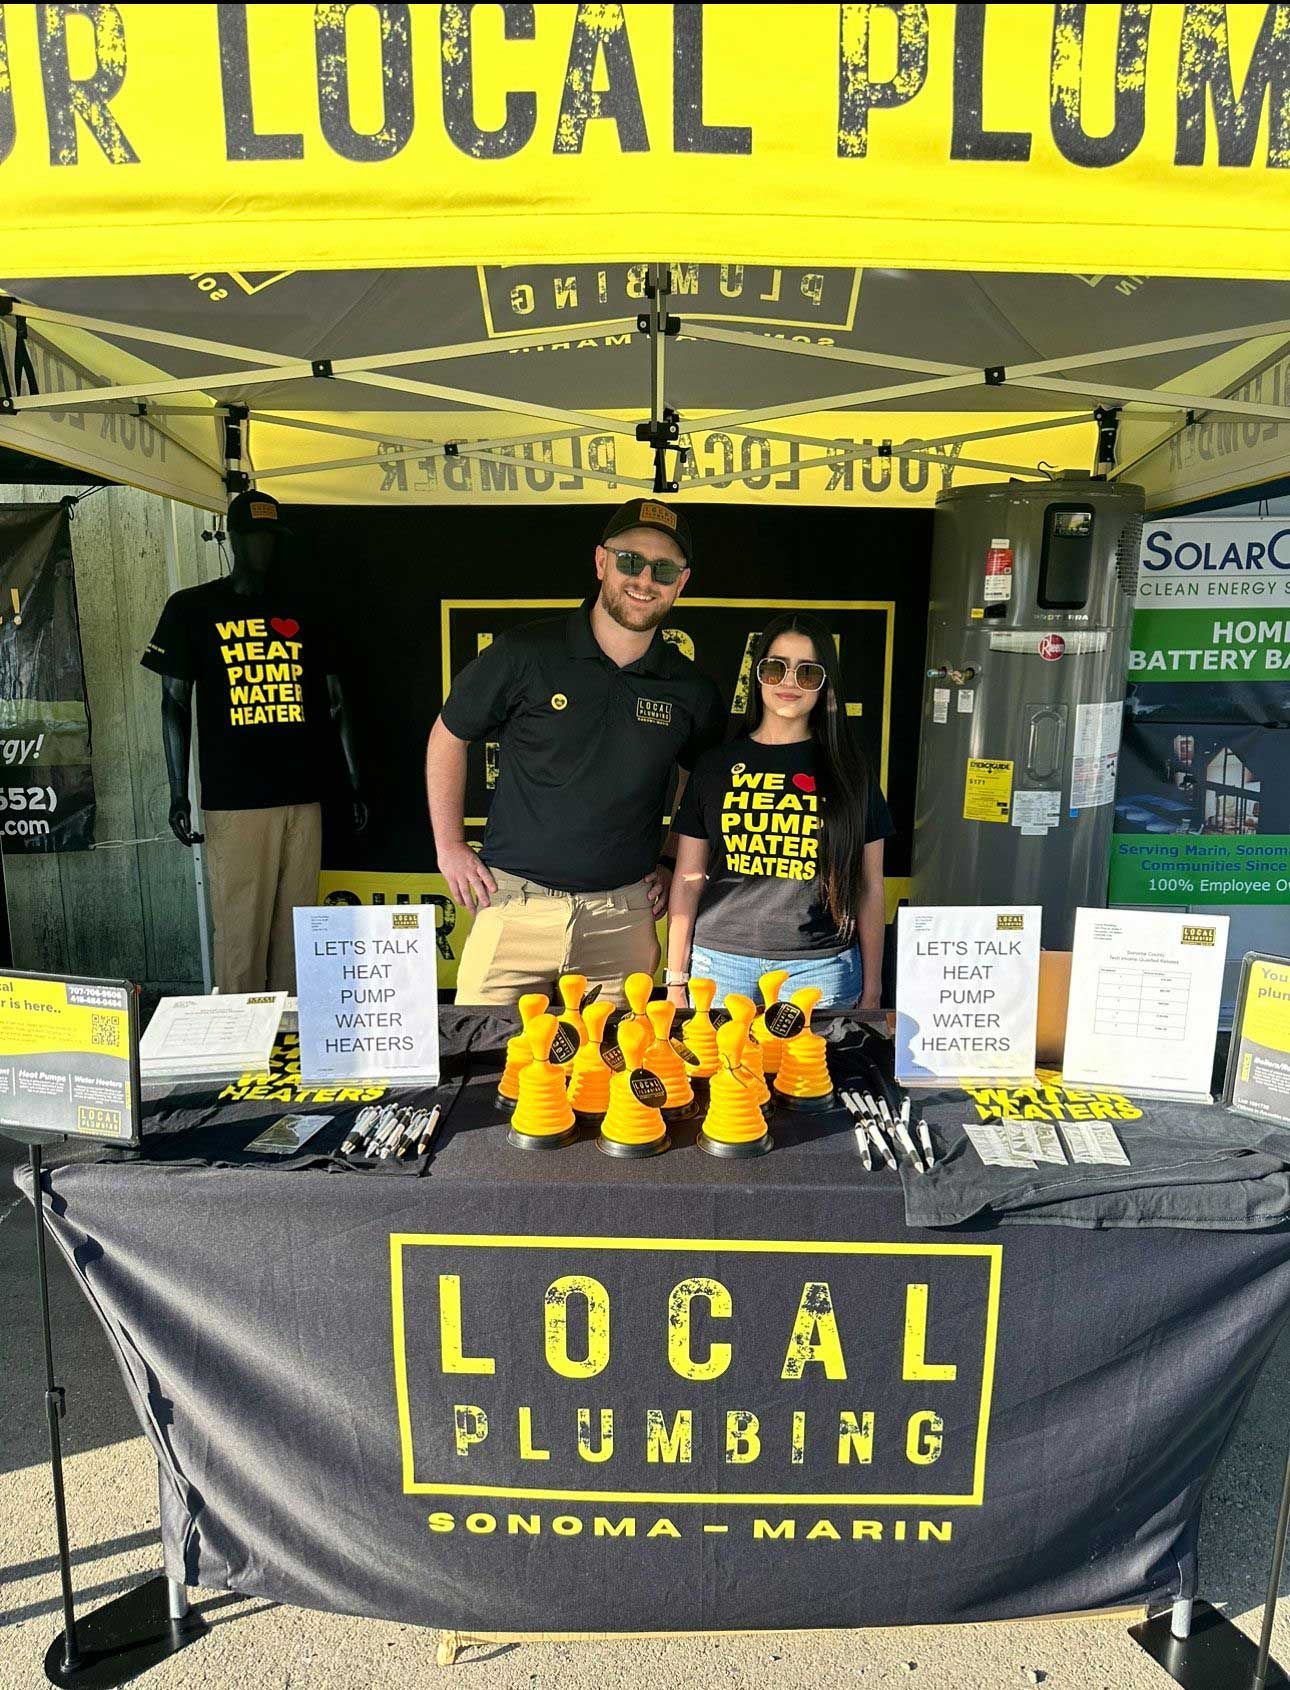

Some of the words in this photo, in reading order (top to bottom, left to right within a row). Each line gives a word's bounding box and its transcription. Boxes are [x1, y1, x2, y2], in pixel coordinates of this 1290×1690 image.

[217, 4, 752, 163] LOCAL
[1140, 582, 1199, 596] CLEAN
[1208, 582, 1277, 595] ENERGY
[215, 619, 268, 640] WE
[220, 641, 303, 665] HEAT
[1128, 649, 1258, 670] BATTERY
[227, 663, 303, 686] PUMP
[639, 700, 670, 714] LOCAL
[732, 772, 786, 790] WE
[723, 834, 819, 859] WATER
[1119, 843, 1179, 858] Serving
[1186, 844, 1231, 857] Marin,
[726, 853, 817, 881] HEATERS
[1141, 859, 1241, 872] Communities
[1246, 860, 1287, 872] Since
[1149, 878, 1194, 892] 100%
[1200, 878, 1271, 894] Employee
[1183, 927, 1214, 937] LOCAL
[314, 940, 367, 956] LET'S
[372, 939, 419, 955] TALK
[916, 940, 968, 955] LET'S
[974, 940, 1022, 955] TALK
[343, 964, 393, 980] HEAT
[943, 965, 993, 980] HEAT
[9, 997, 21, 1009] is
[341, 988, 396, 1005] PUMP
[939, 989, 996, 1004] PUMP
[335, 1012, 403, 1028] WATER
[933, 1013, 1001, 1028] WATER
[325, 1036, 414, 1053] HEATERS
[921, 1037, 1011, 1052] HEATERS
[19, 1069, 40, 1079] Heat
[81, 1109, 120, 1123] LOCAL
[439, 1274, 957, 1381] LOCAL
[453, 1404, 944, 1465] PLUMBING
[428, 1511, 682, 1538] SONOMA
[753, 1518, 952, 1542] MARIN
